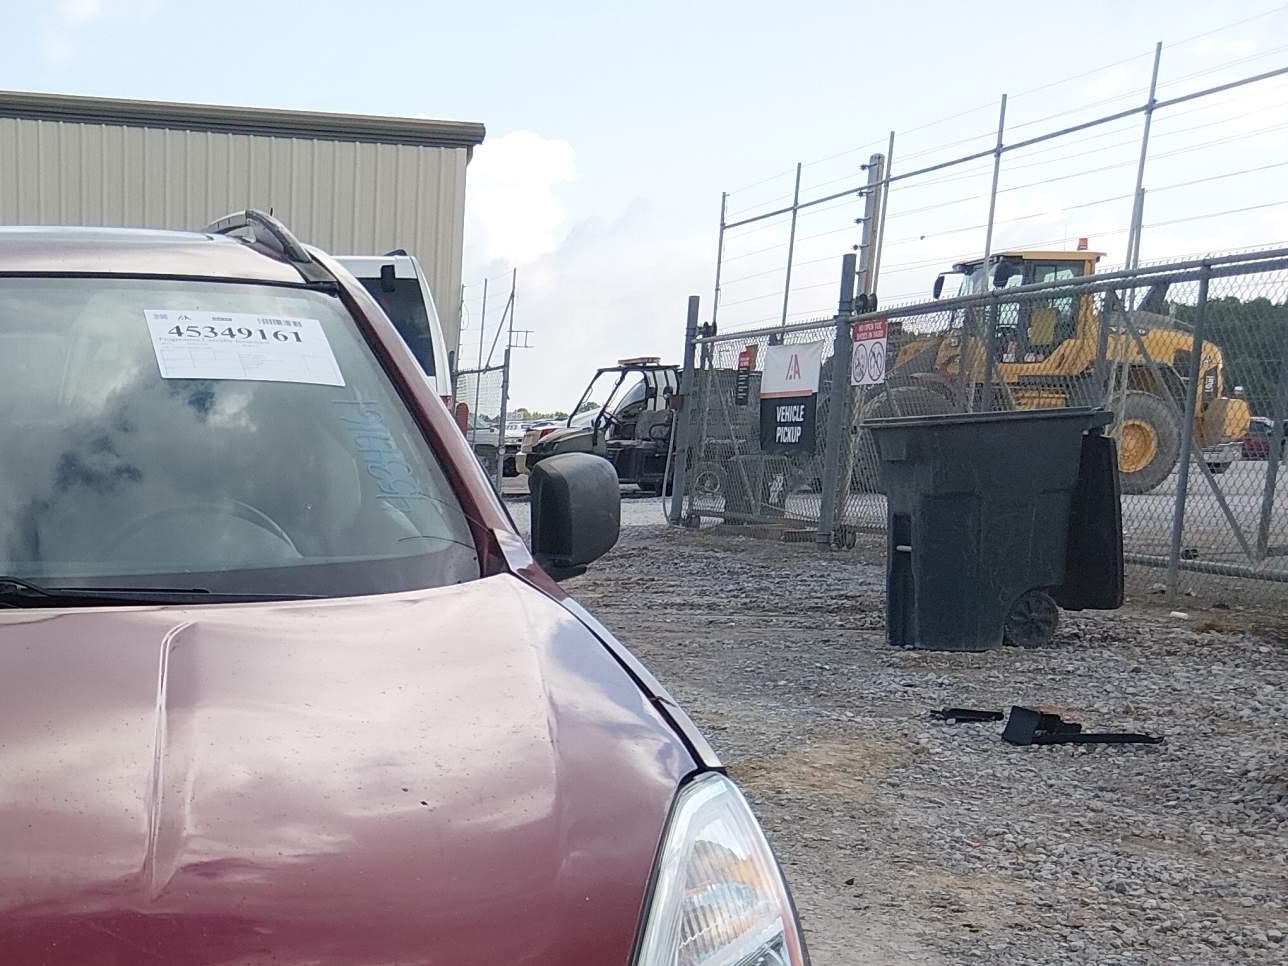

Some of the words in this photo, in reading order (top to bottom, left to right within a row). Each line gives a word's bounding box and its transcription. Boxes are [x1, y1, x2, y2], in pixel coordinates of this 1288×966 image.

[167, 325, 302, 343] 45349161
[776, 404, 805, 422] VEHICLE
[775, 426, 802, 443] PICKUP
